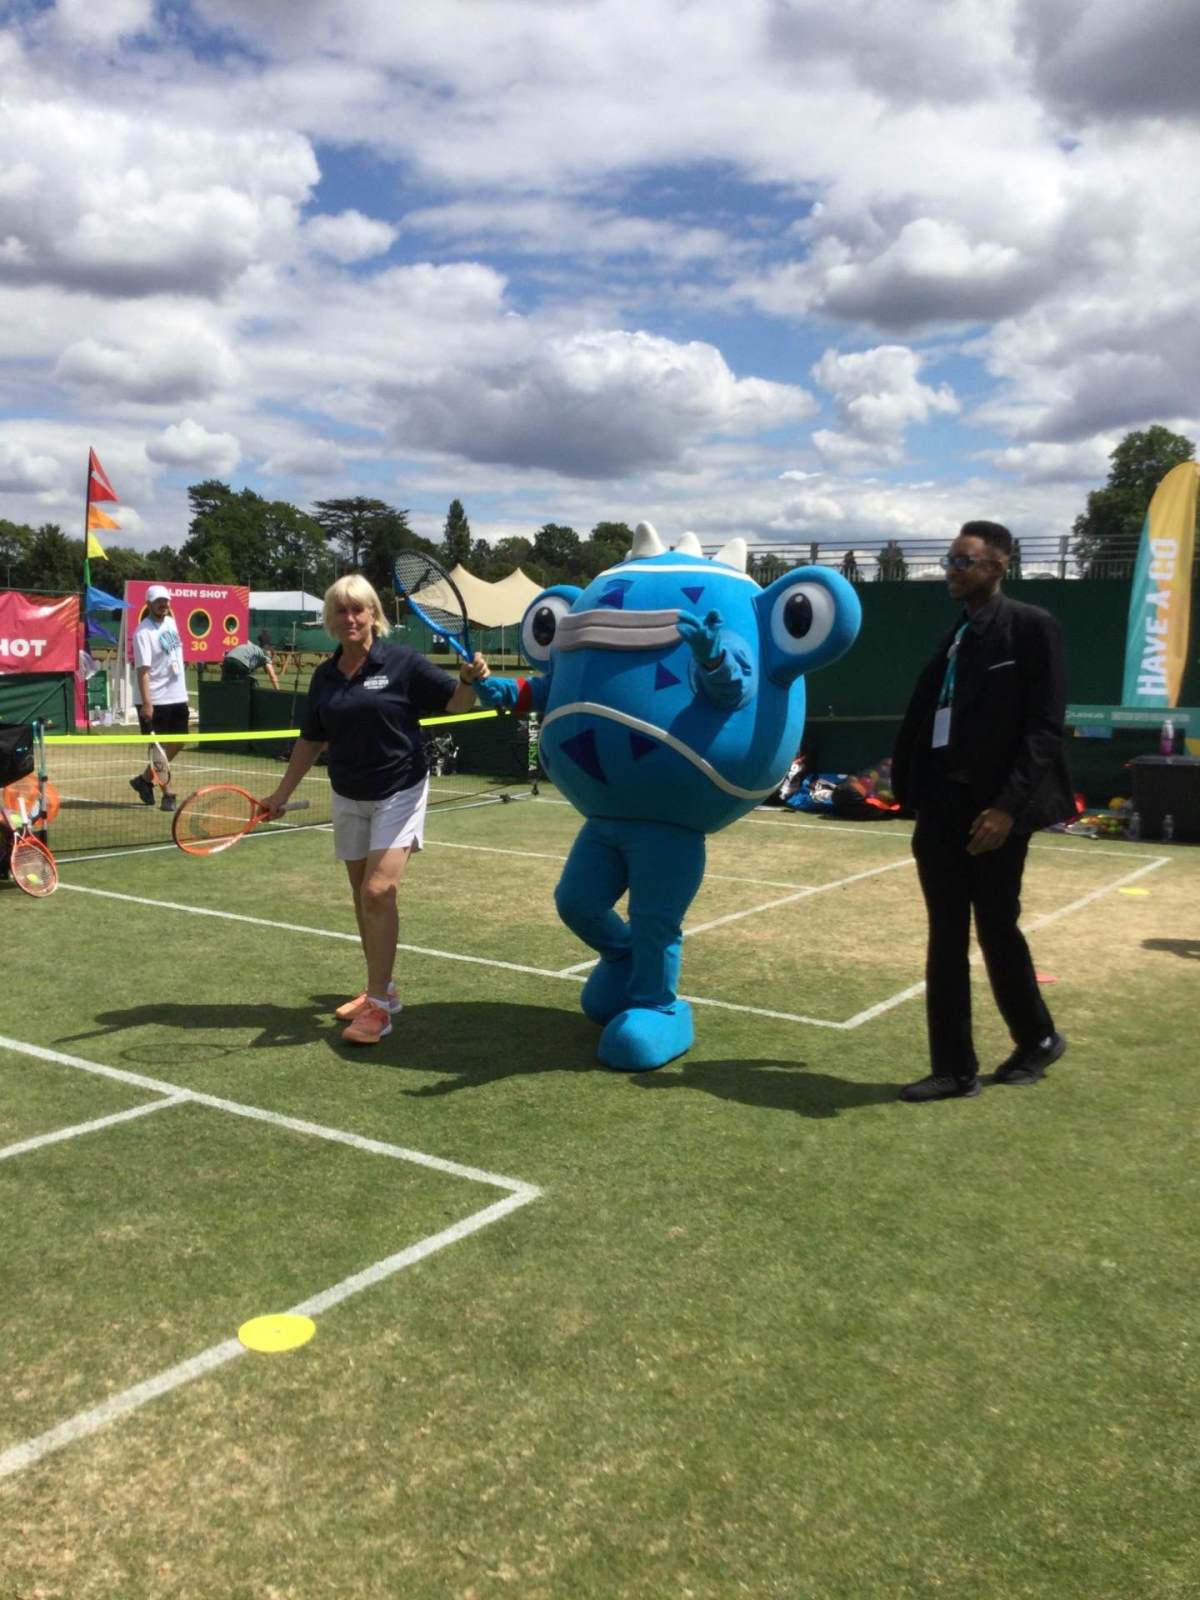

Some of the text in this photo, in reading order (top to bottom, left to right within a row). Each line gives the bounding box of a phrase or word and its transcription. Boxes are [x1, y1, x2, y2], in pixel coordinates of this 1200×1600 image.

[168, 588, 228, 600] LDEN SHOT
[1145, 590, 1172, 609] A
[0, 638, 47, 657] HOT
[191, 640, 208, 651] 30
[222, 636, 239, 646] 40
[1137, 617, 1168, 695] HAVE
